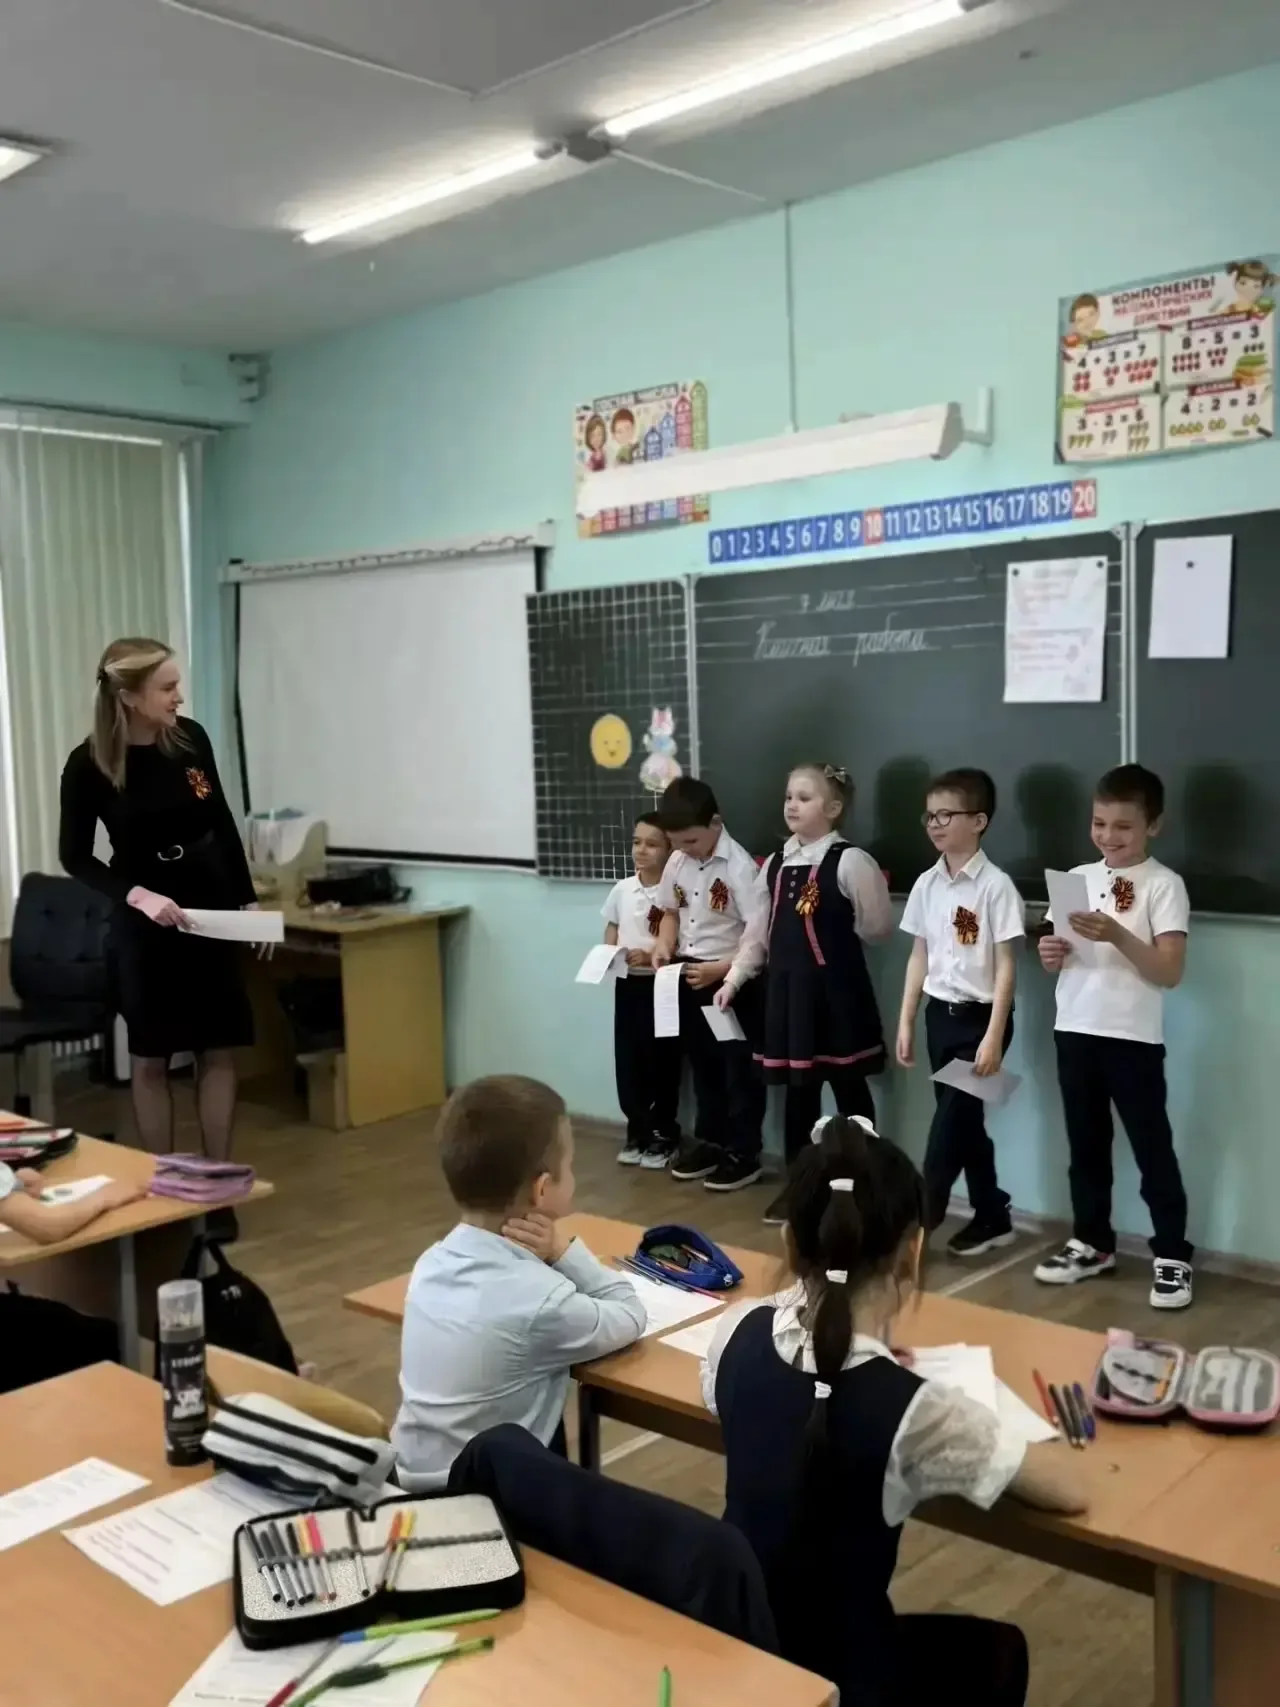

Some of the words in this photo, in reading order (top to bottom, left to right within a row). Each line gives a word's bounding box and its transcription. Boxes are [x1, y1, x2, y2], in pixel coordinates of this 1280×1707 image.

[1111, 275, 1215, 305] КОМПОНЕНТЫ
[1214, 331, 1224, 345] 5
[1250, 324, 1259, 339] 3
[1077, 357, 1086, 368] 4
[1108, 350, 1116, 363] 3
[1137, 343, 1146, 357] 7
[1181, 403, 1190, 415] 4
[1211, 398, 1220, 412] 2
[1247, 393, 1256, 407] 2
[1078, 418, 1087, 431] 3
[712, 535, 722, 558] 0
[727, 534, 735, 557] 1
[742, 531, 751, 555] 2
[756, 529, 765, 553] 3
[770, 527, 780, 550] 4
[785, 524, 795, 549] 5
[801, 524, 811, 547] 6
[817, 521, 827, 545] 7
[833, 518, 844, 543] 8
[850, 516, 861, 541] 9
[866, 513, 882, 538] 10
[885, 510, 900, 536] 11
[905, 508, 920, 534] 12
[924, 506, 940, 531] 13
[944, 503, 963, 529] 14
[965, 500, 981, 527] 15
[985, 498, 1004, 524] 16
[1008, 494, 1025, 521] 17
[1030, 491, 1049, 518] 18
[1052, 488, 1072, 515] 19
[1074, 484, 1096, 513] 20
